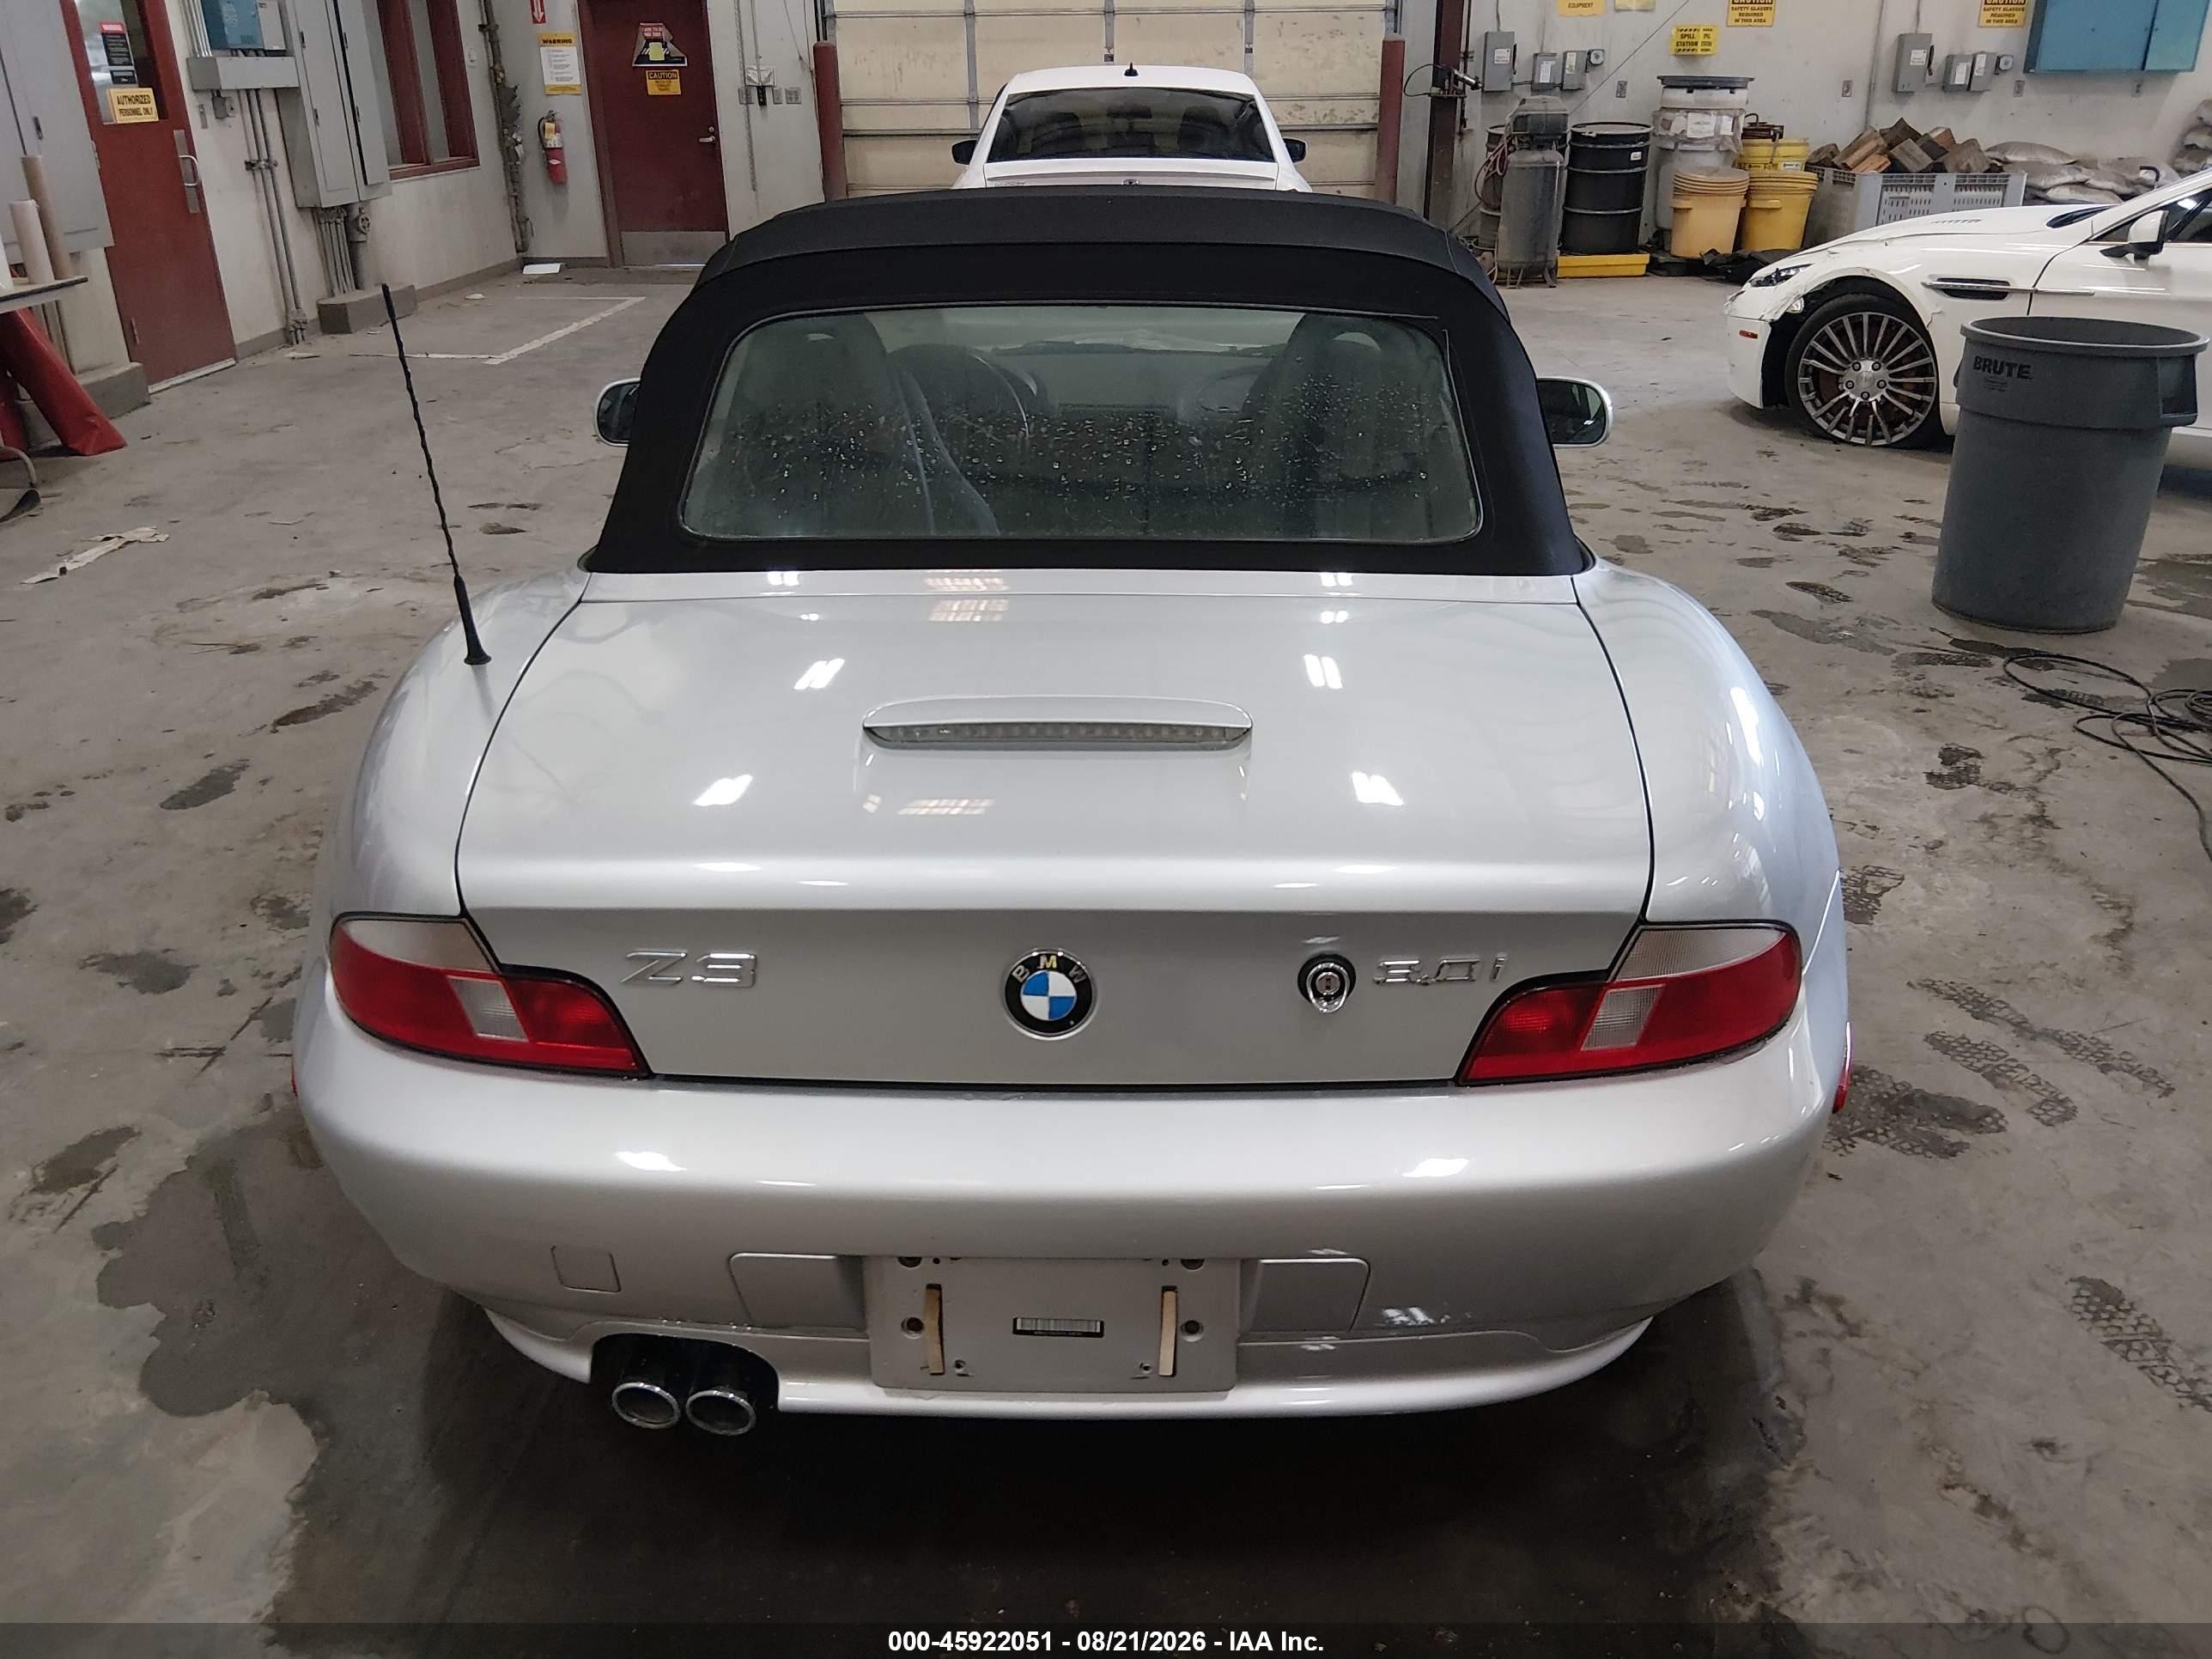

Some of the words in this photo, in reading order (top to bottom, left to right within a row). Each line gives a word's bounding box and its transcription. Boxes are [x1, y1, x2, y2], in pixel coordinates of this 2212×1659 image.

[116, 94, 151, 106] AUTHORIZED
[118, 107, 143, 117] PERSONNEL
[143, 106, 153, 116] ONLY
[1972, 356, 2032, 380] BRUTE
[621, 950, 757, 988] Z3
[1012, 955, 1086, 983] BMW
